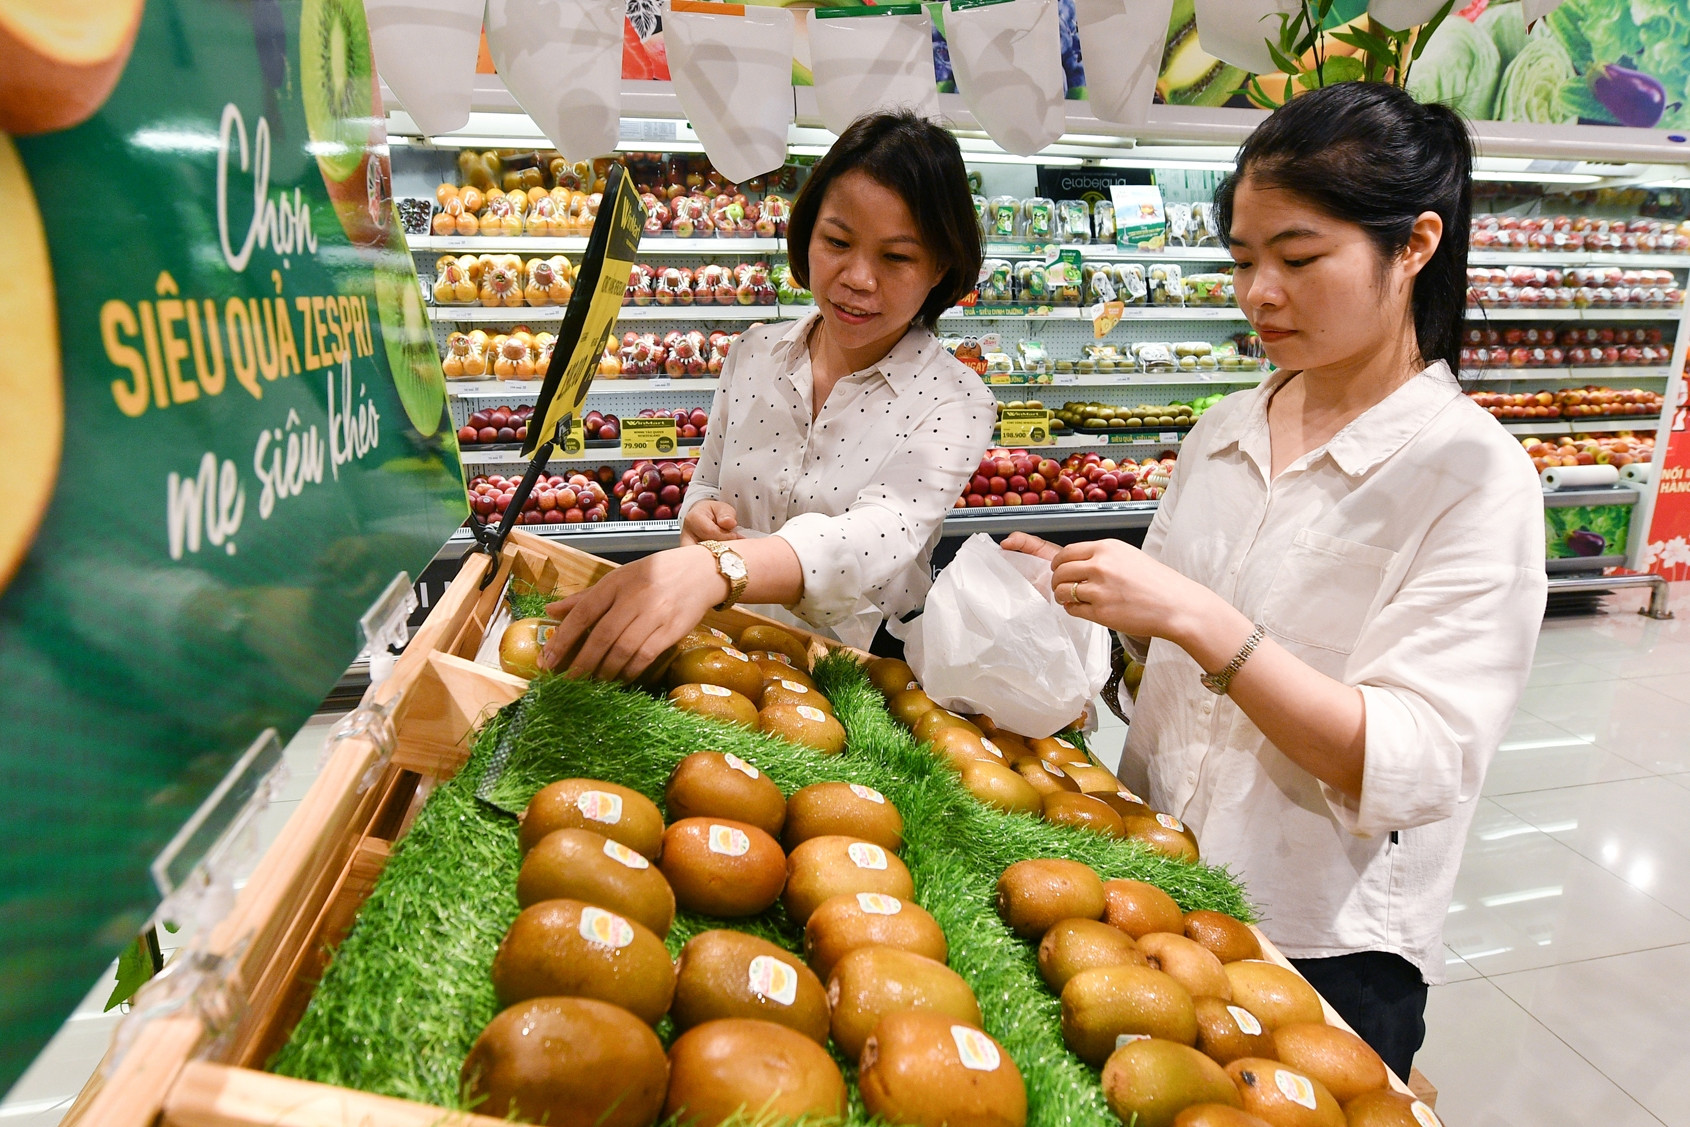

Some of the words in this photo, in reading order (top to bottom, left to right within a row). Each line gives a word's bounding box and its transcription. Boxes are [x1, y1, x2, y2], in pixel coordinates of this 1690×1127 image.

[217, 103, 318, 273] Chọn
[100, 270, 226, 417] SIÊU
[225, 269, 301, 400] QUẢ
[295, 295, 374, 371] ZESPRI
[253, 407, 325, 520] siêu
[327, 350, 380, 482] khéo
[623, 442, 647, 450] 79.900
[1661, 465, 1684, 479] NỐI
